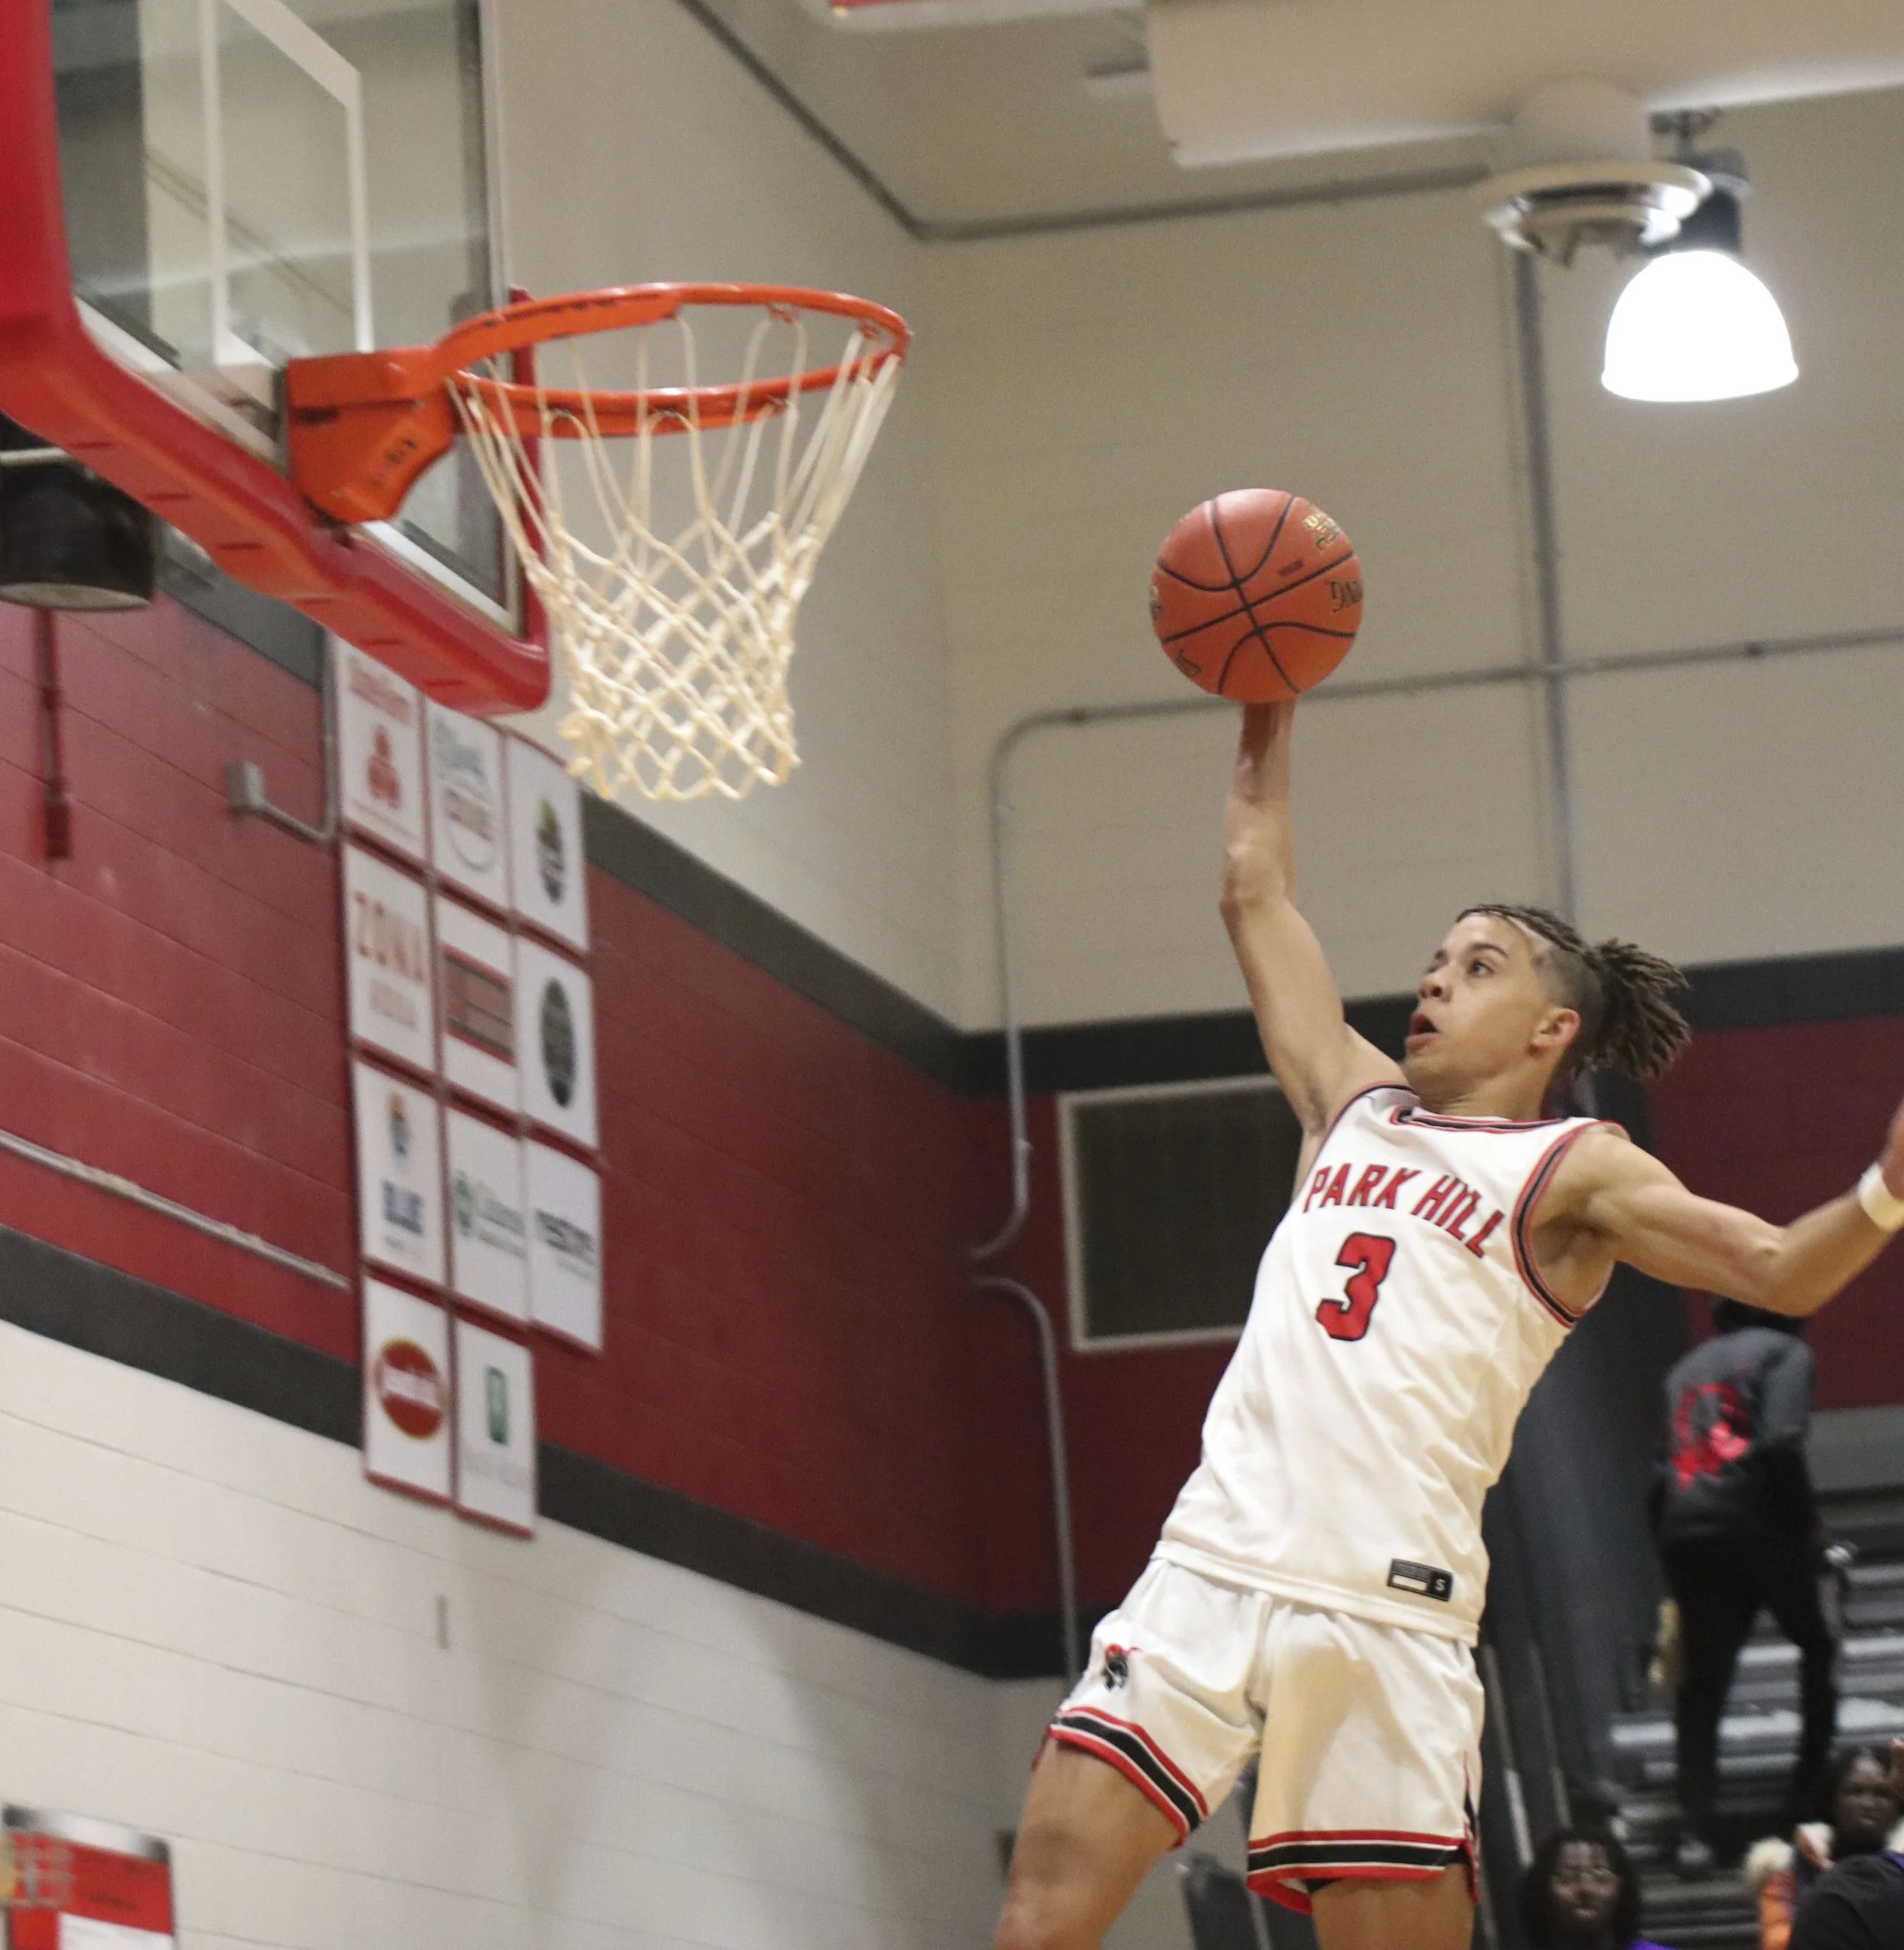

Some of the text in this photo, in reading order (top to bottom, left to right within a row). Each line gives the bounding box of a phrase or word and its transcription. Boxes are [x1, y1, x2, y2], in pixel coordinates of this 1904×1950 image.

[1302, 1162, 1506, 1259] PARK HILL
[1315, 1230, 1396, 1342] 3
[1434, 1578, 1446, 1592] S
